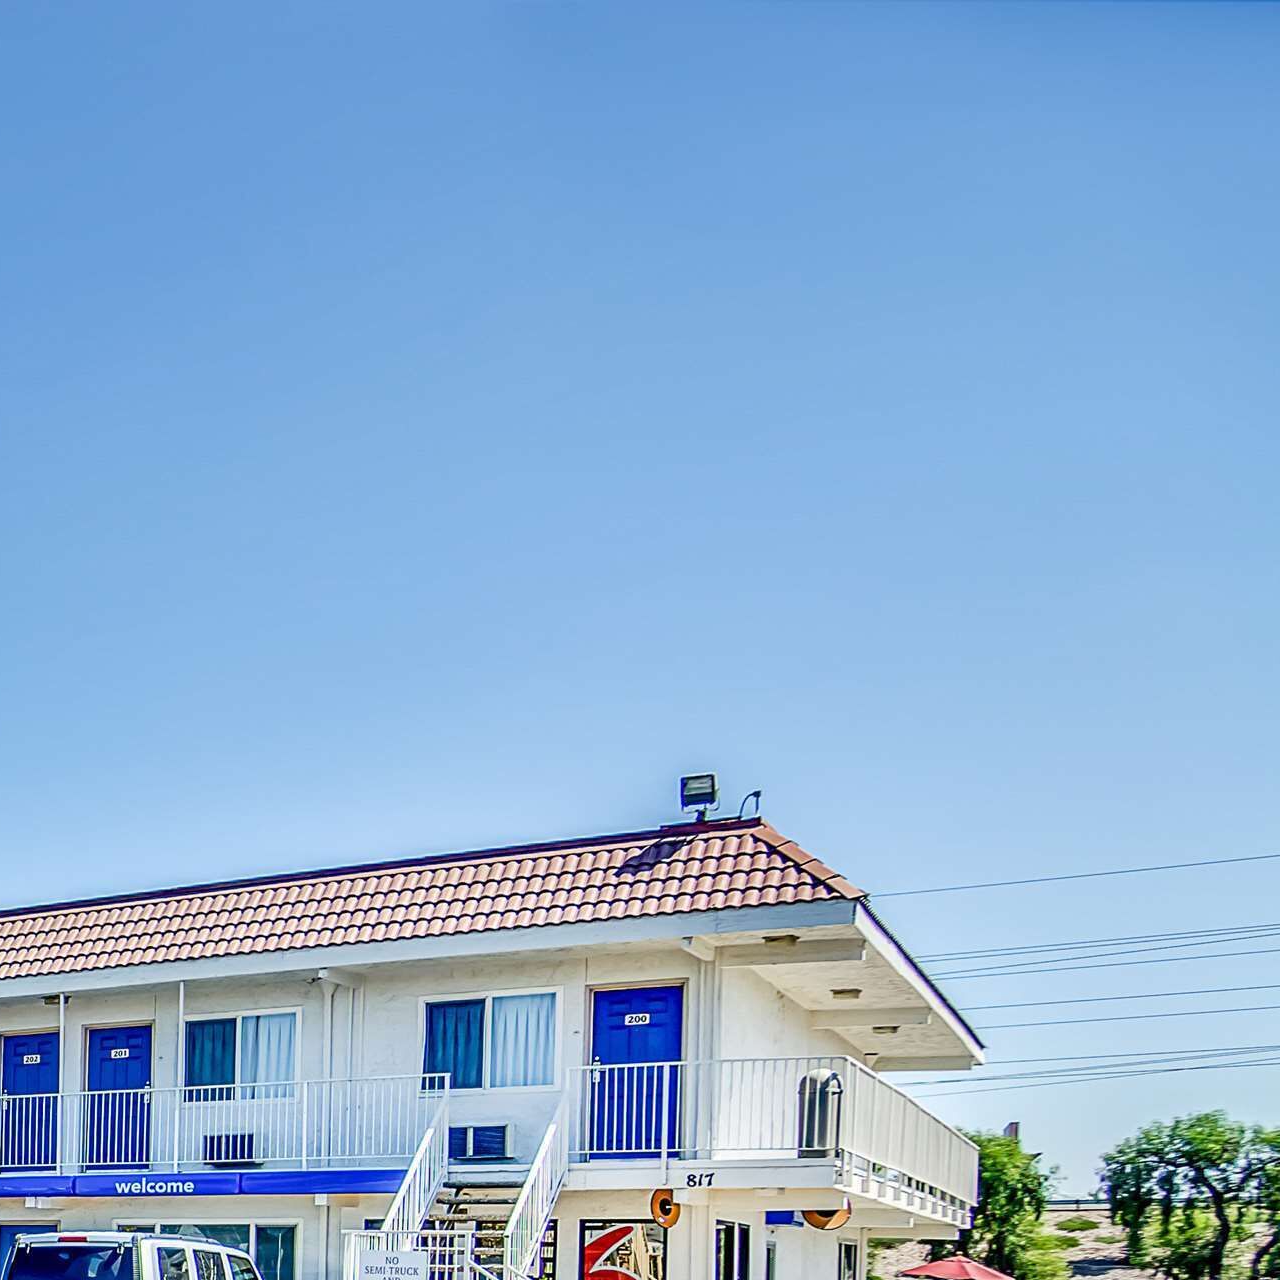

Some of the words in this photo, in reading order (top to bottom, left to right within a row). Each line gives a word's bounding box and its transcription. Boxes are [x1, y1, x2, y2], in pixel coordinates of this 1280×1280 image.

[627, 1014, 648, 1024] 200
[113, 1049, 128, 1058] 201
[24, 1055, 39, 1064] 202
[686, 1172, 715, 1187] 817
[114, 1177, 195, 1194] welcome
[385, 1256, 399, 1265] NO
